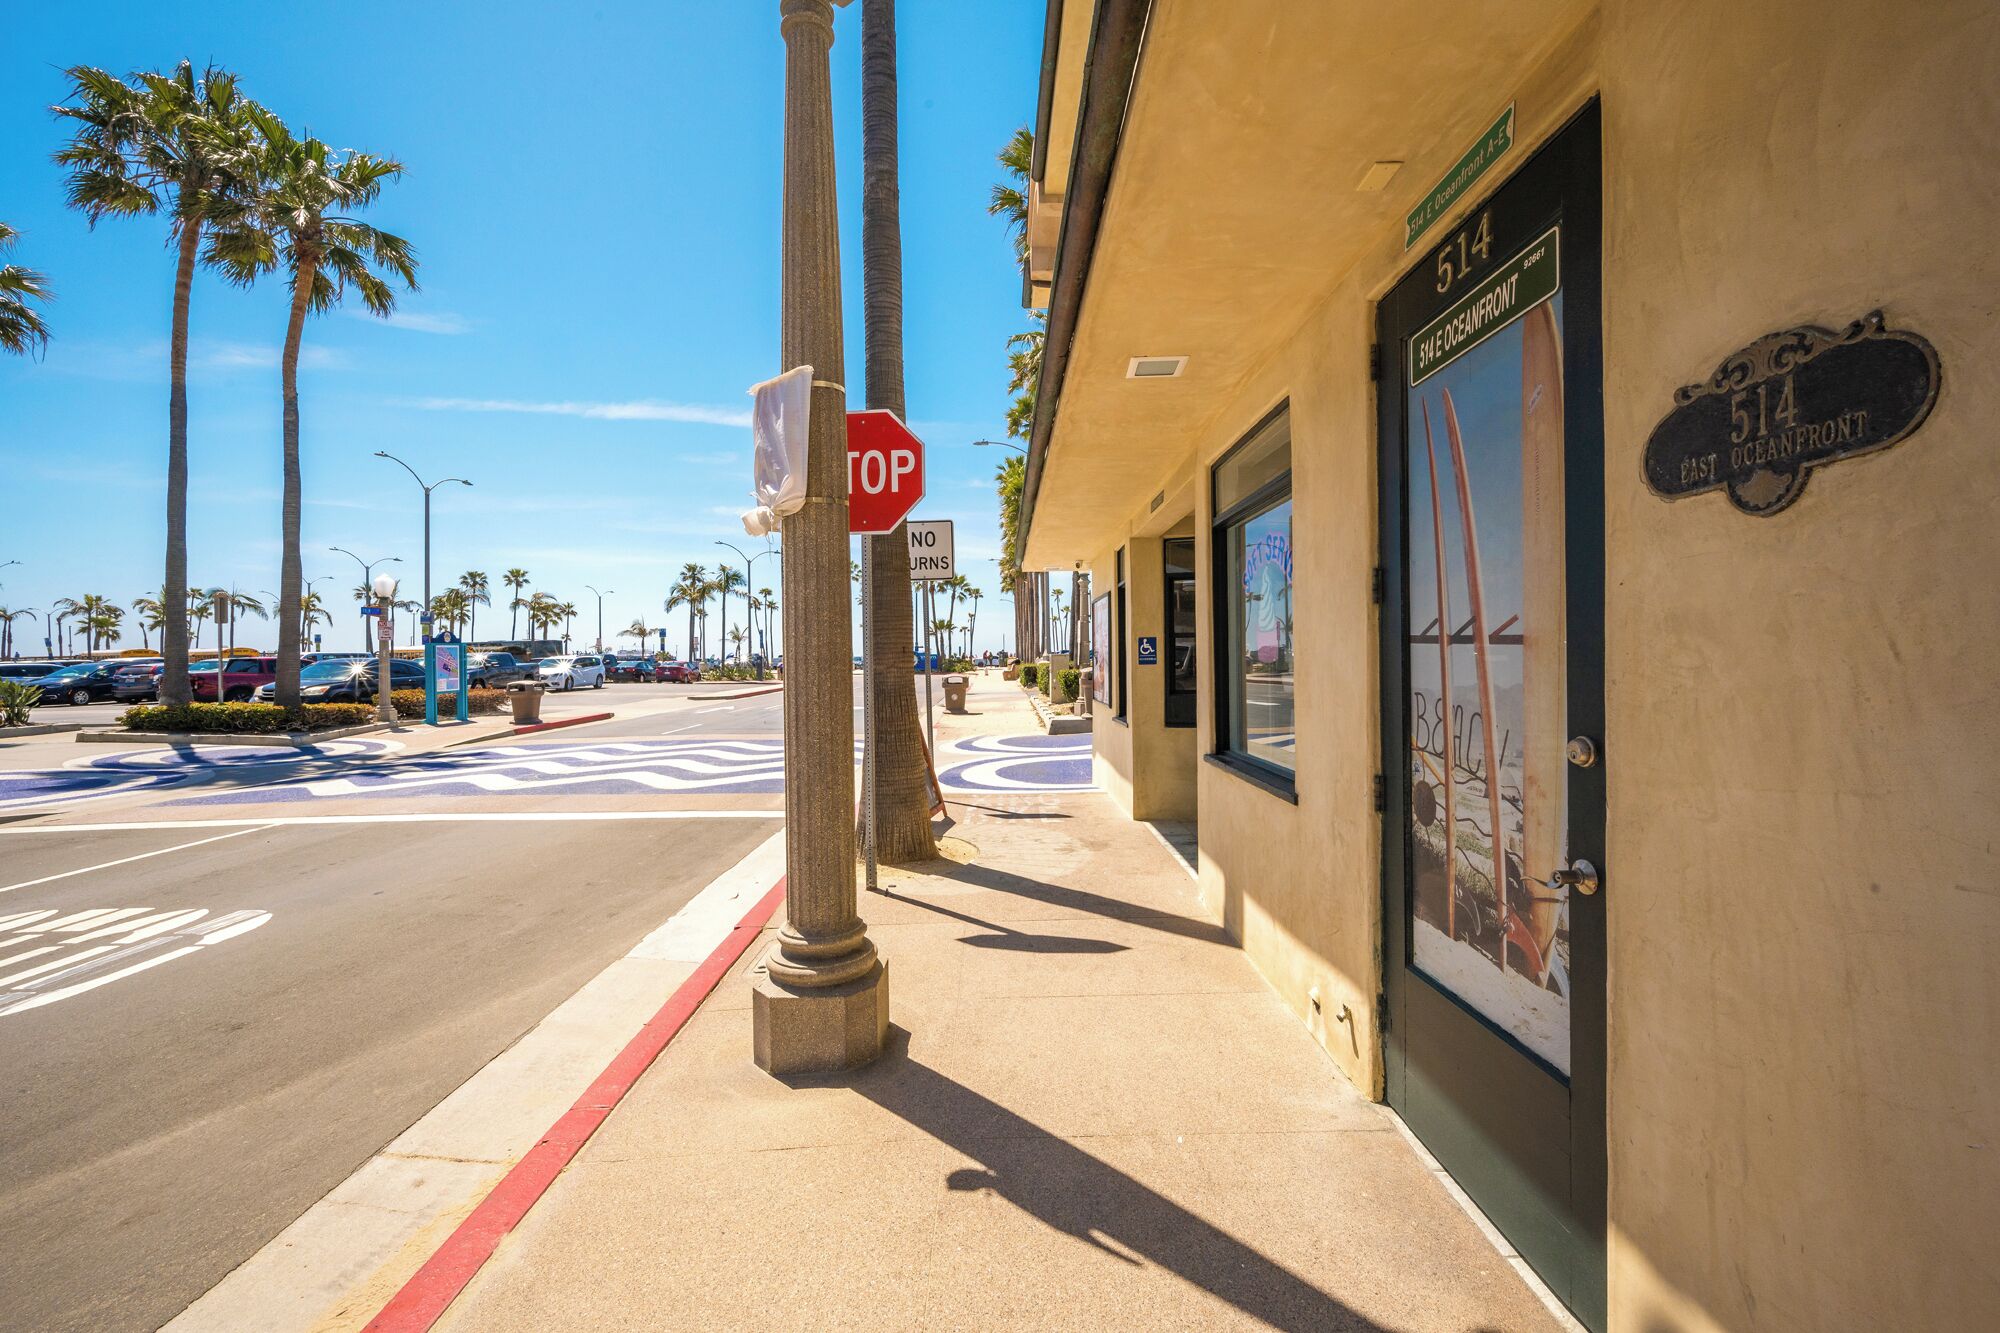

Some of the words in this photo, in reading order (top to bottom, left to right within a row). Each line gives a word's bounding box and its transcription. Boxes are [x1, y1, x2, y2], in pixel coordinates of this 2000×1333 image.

[1411, 212, 1424, 236] 514
[1427, 206, 1432, 219] E
[1434, 149, 1484, 207] Oceanfront
[1487, 125, 1506, 159] A-E
[1436, 211, 1495, 294] 514
[1523, 247, 1546, 270] 92661
[1419, 339, 1434, 369] 514
[1435, 329, 1443, 357] E
[1444, 273, 1519, 351] OCEANFRONT
[1730, 374, 1801, 444] 514
[847, 449, 916, 495] TOP
[1680, 453, 1719, 484] EAST
[1731, 410, 1871, 470] OCEANFRONT
[910, 556, 950, 571] URNS
[911, 531, 936, 548] NO
